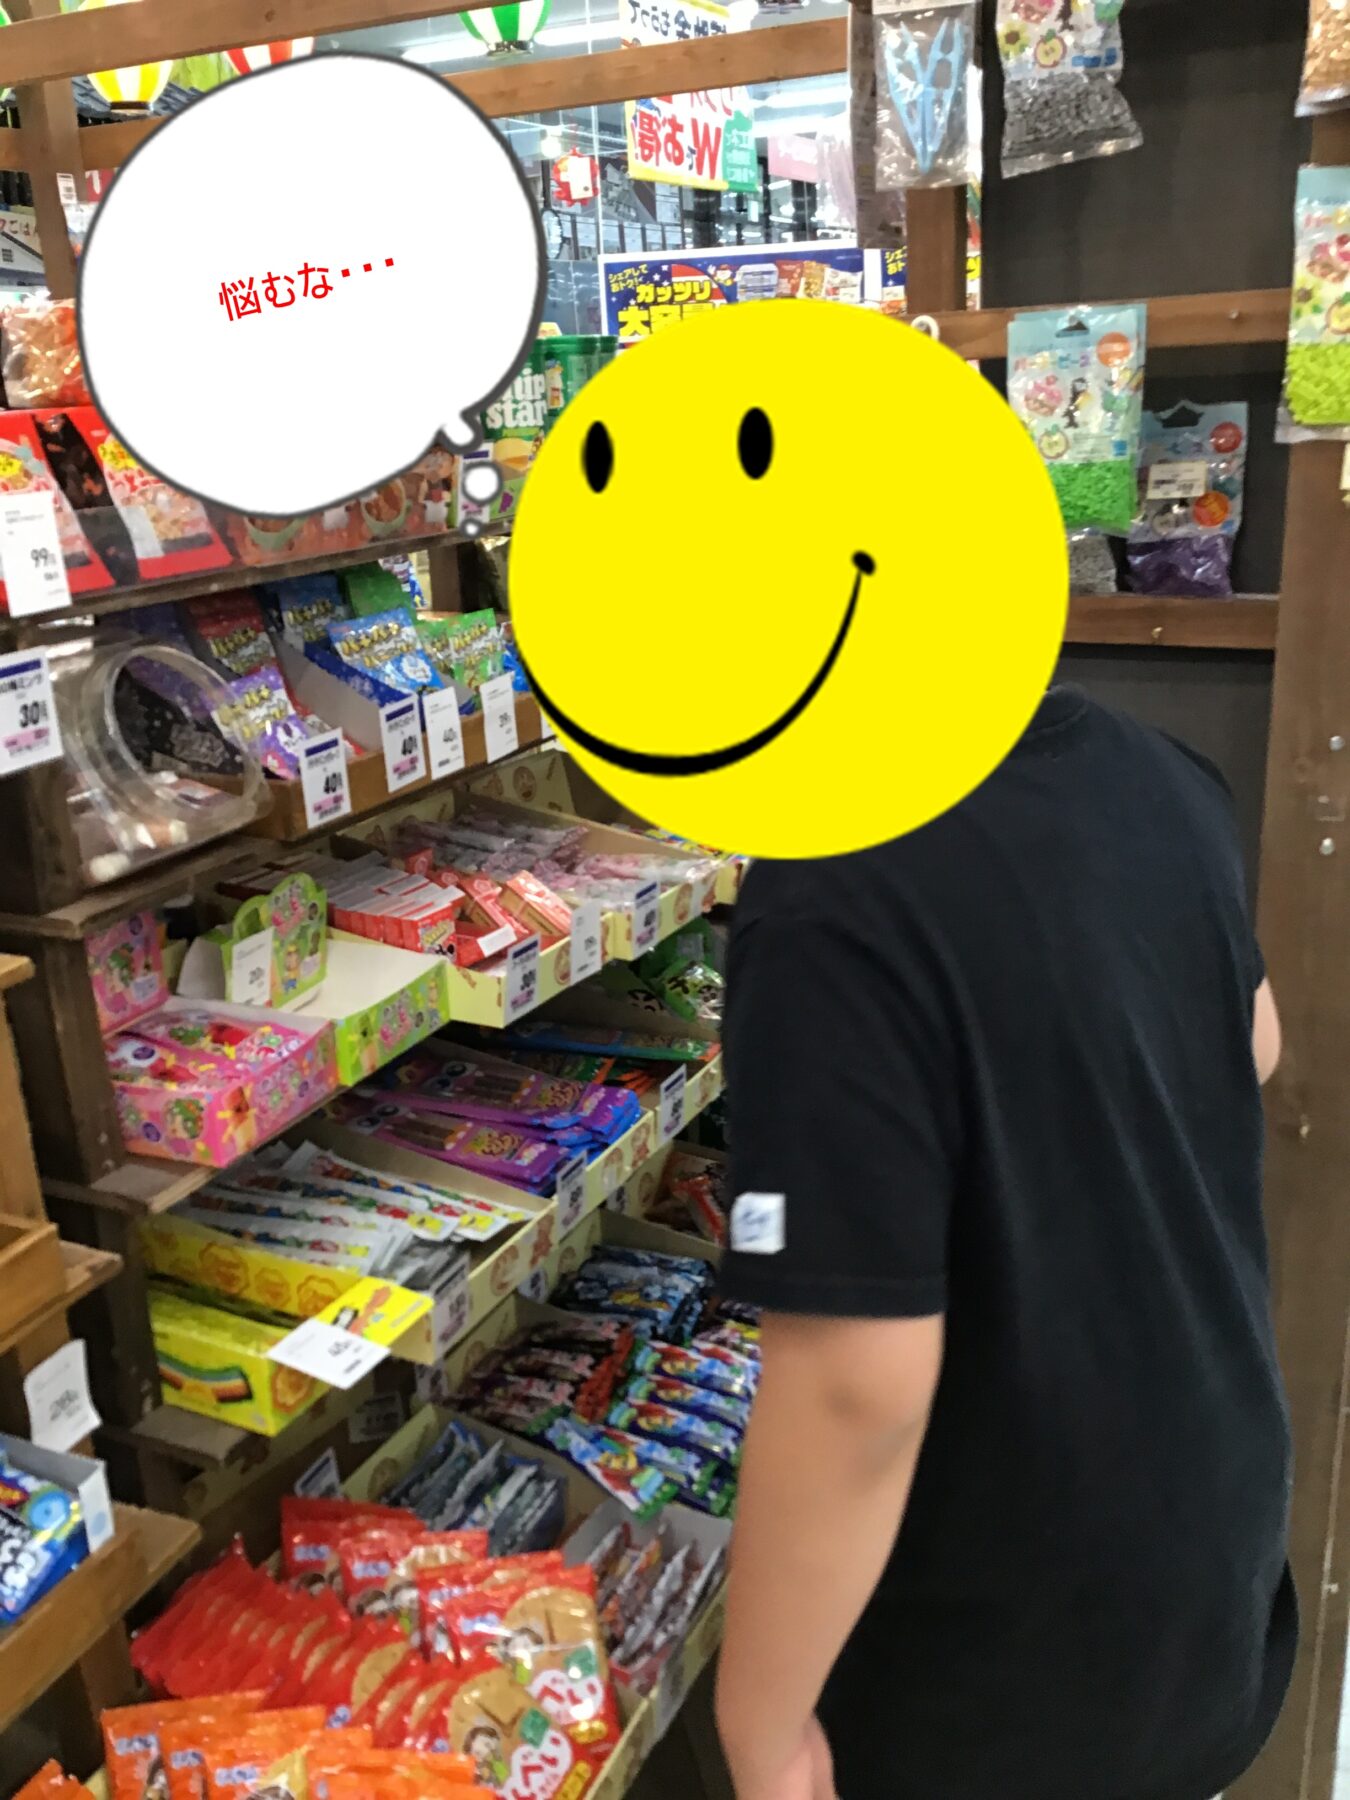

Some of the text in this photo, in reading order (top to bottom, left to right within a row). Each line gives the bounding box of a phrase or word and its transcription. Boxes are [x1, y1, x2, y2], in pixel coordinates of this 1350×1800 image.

[609, 264, 648, 282] シェアして
[636, 280, 712, 303] ガッツリ
[486, 399, 547, 430] star
